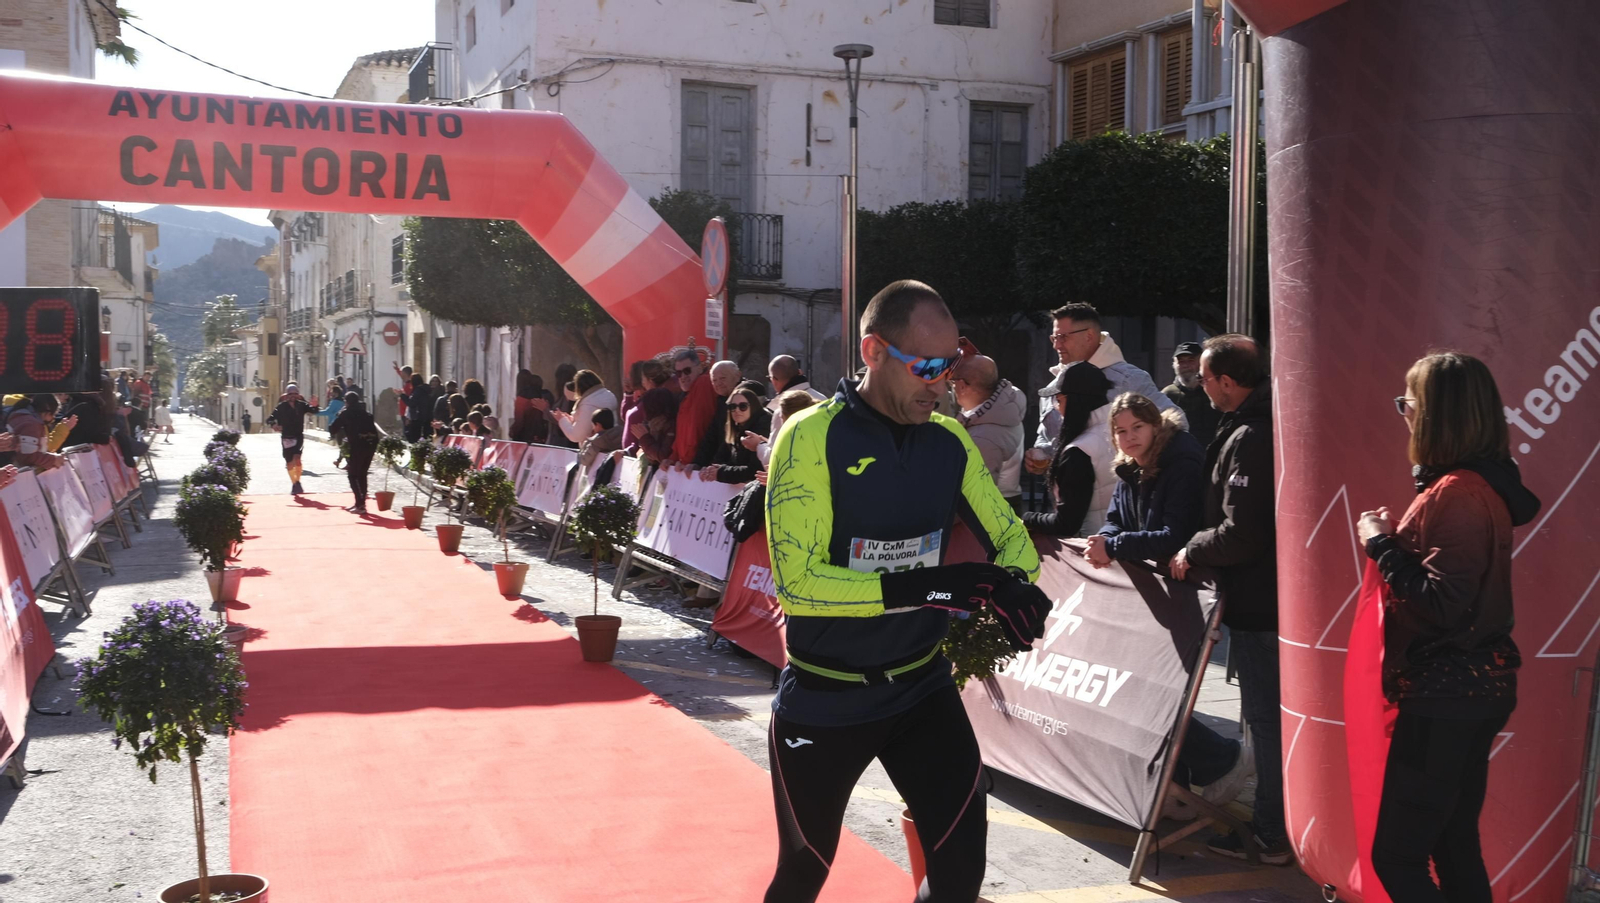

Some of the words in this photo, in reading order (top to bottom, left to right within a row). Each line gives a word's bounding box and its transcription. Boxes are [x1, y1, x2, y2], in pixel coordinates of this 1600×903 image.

[109, 90, 463, 139] AYUNTAMIENTO
[119, 135, 451, 200] CANTORIA
[0, 298, 75, 381] 8
[863, 552, 874, 560] LA
[878, 550, 917, 560] PÓLVORA
[868, 541, 879, 550] IV
[883, 541, 905, 550] CxM
[990, 649, 1133, 707] AMERGY
